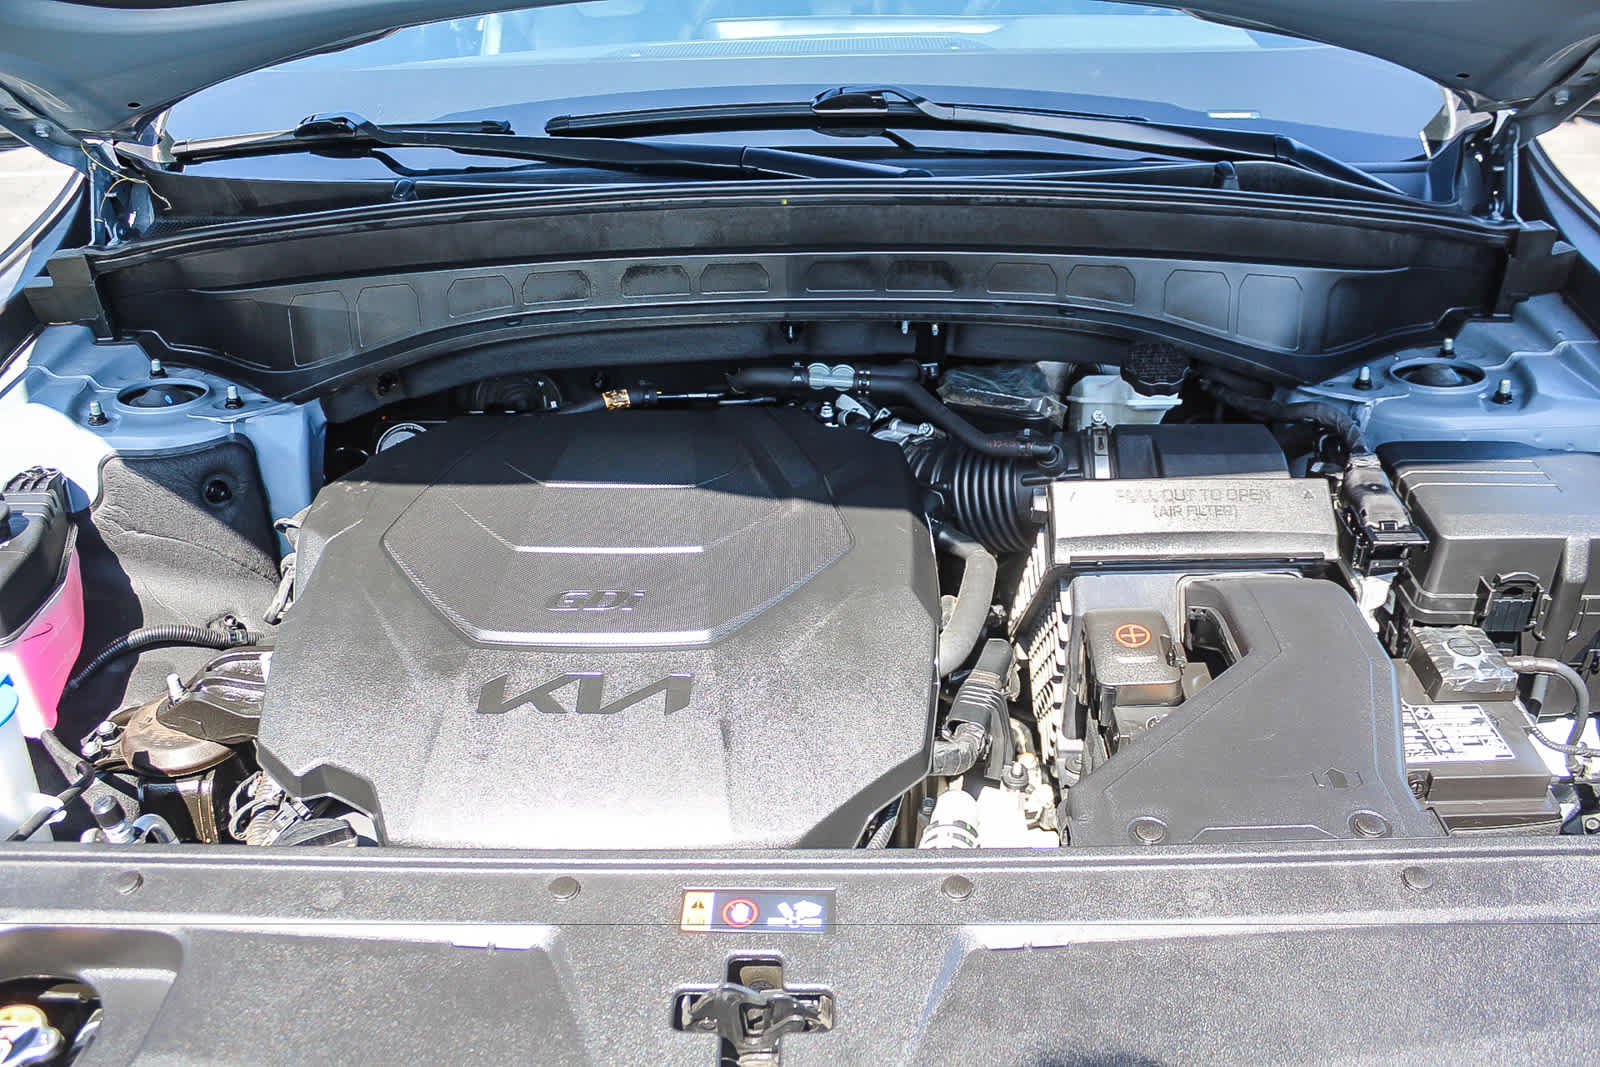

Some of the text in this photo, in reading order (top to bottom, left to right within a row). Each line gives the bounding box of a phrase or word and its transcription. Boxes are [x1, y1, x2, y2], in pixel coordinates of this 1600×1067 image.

[1200, 488, 1222, 501] TO
[1226, 488, 1272, 501] OPEN
[477, 670, 694, 716] KIA
